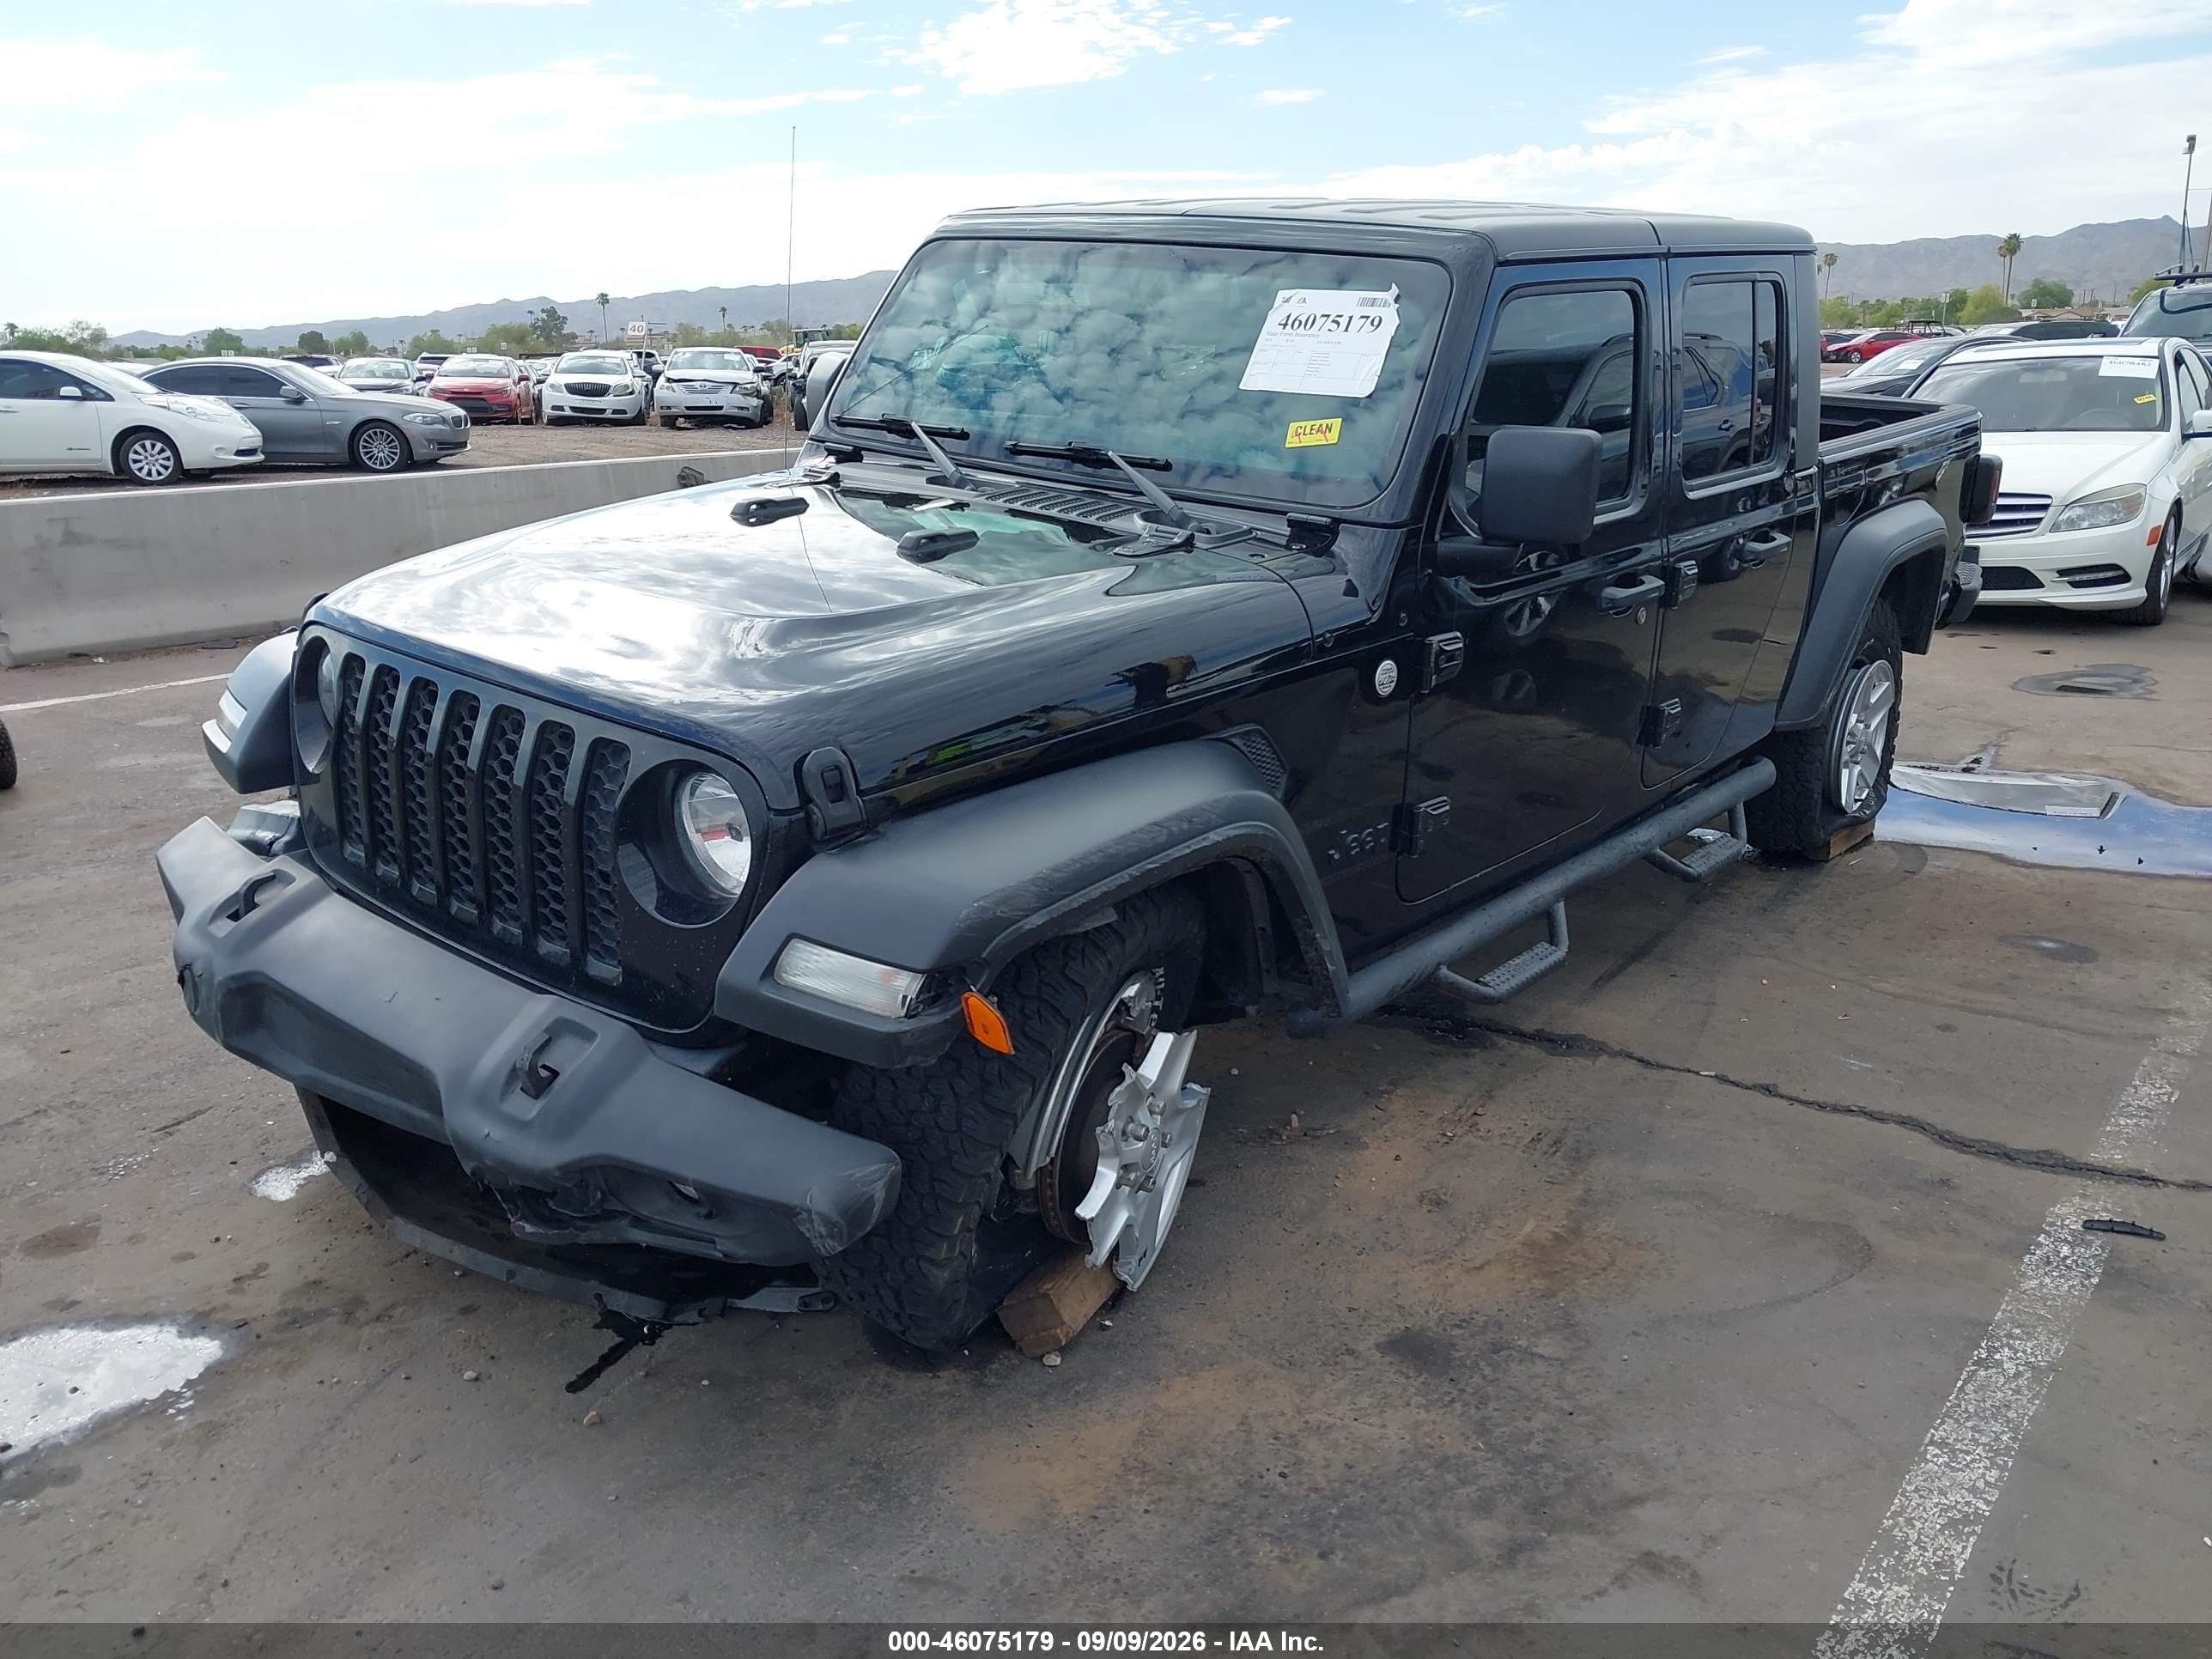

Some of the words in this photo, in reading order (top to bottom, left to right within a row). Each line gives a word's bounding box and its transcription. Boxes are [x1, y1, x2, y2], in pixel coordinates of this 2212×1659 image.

[629, 325, 644, 333] 40
[1278, 312, 1382, 334] 46075179
[1294, 422, 1334, 437] CLEAN
